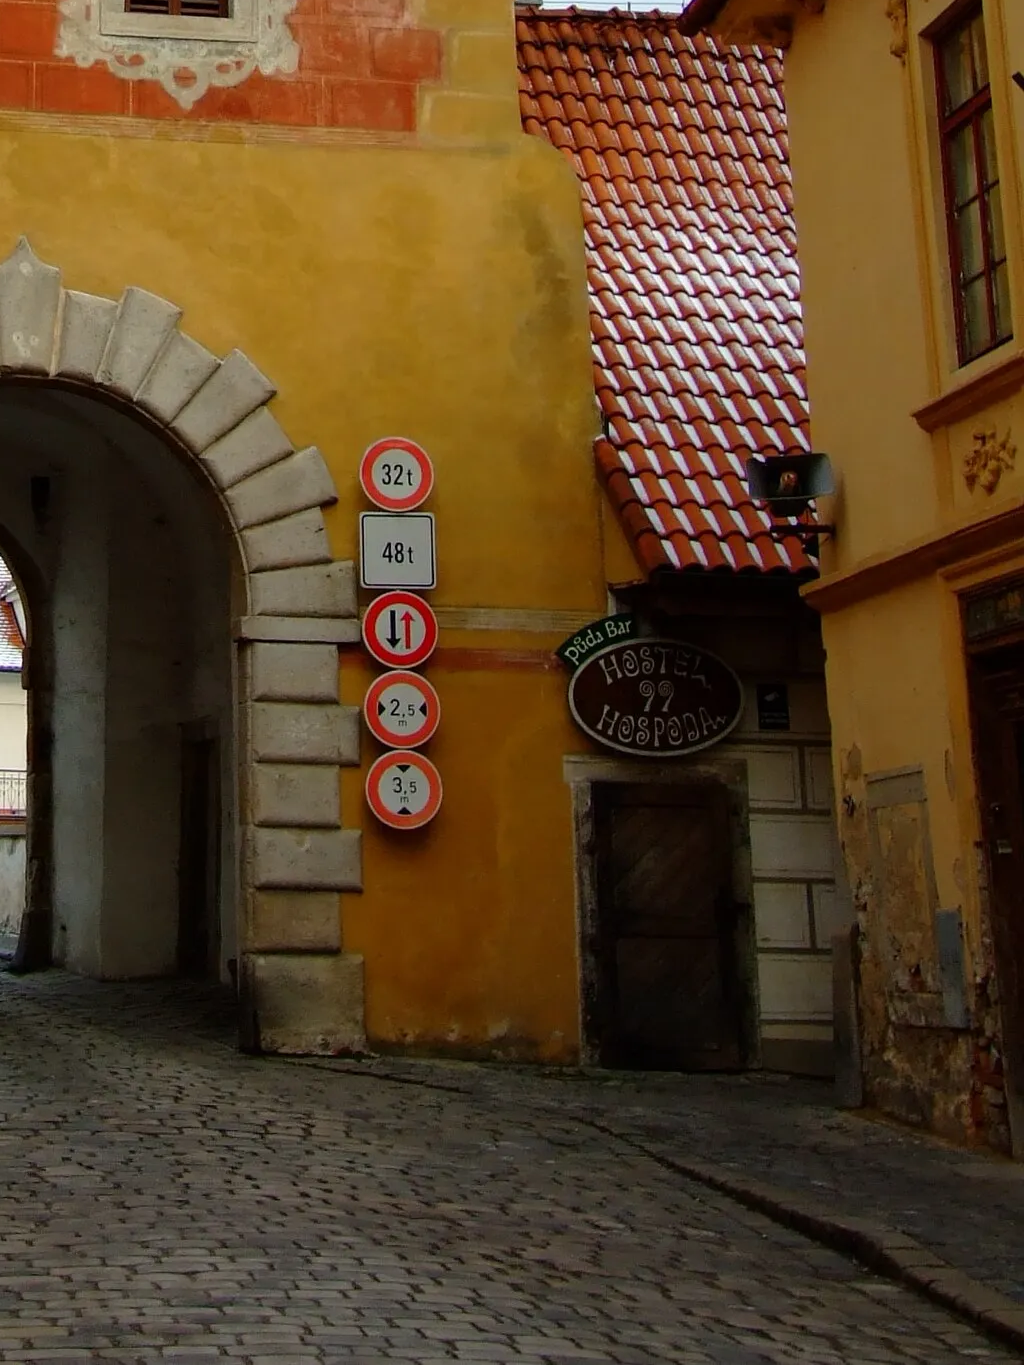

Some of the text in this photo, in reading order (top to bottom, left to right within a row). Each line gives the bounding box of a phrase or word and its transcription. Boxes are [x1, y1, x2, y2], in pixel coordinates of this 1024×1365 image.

[382, 464, 414, 487] 32 t
[382, 542, 414, 565] 48 t
[605, 618, 633, 638] Bar
[599, 646, 713, 692] HOSTEL
[638, 679, 675, 713] 99
[389, 699, 416, 719] 2,5
[596, 703, 728, 748] HOSPODA
[392, 777, 417, 796] 3,5
[399, 795, 410, 803] m
